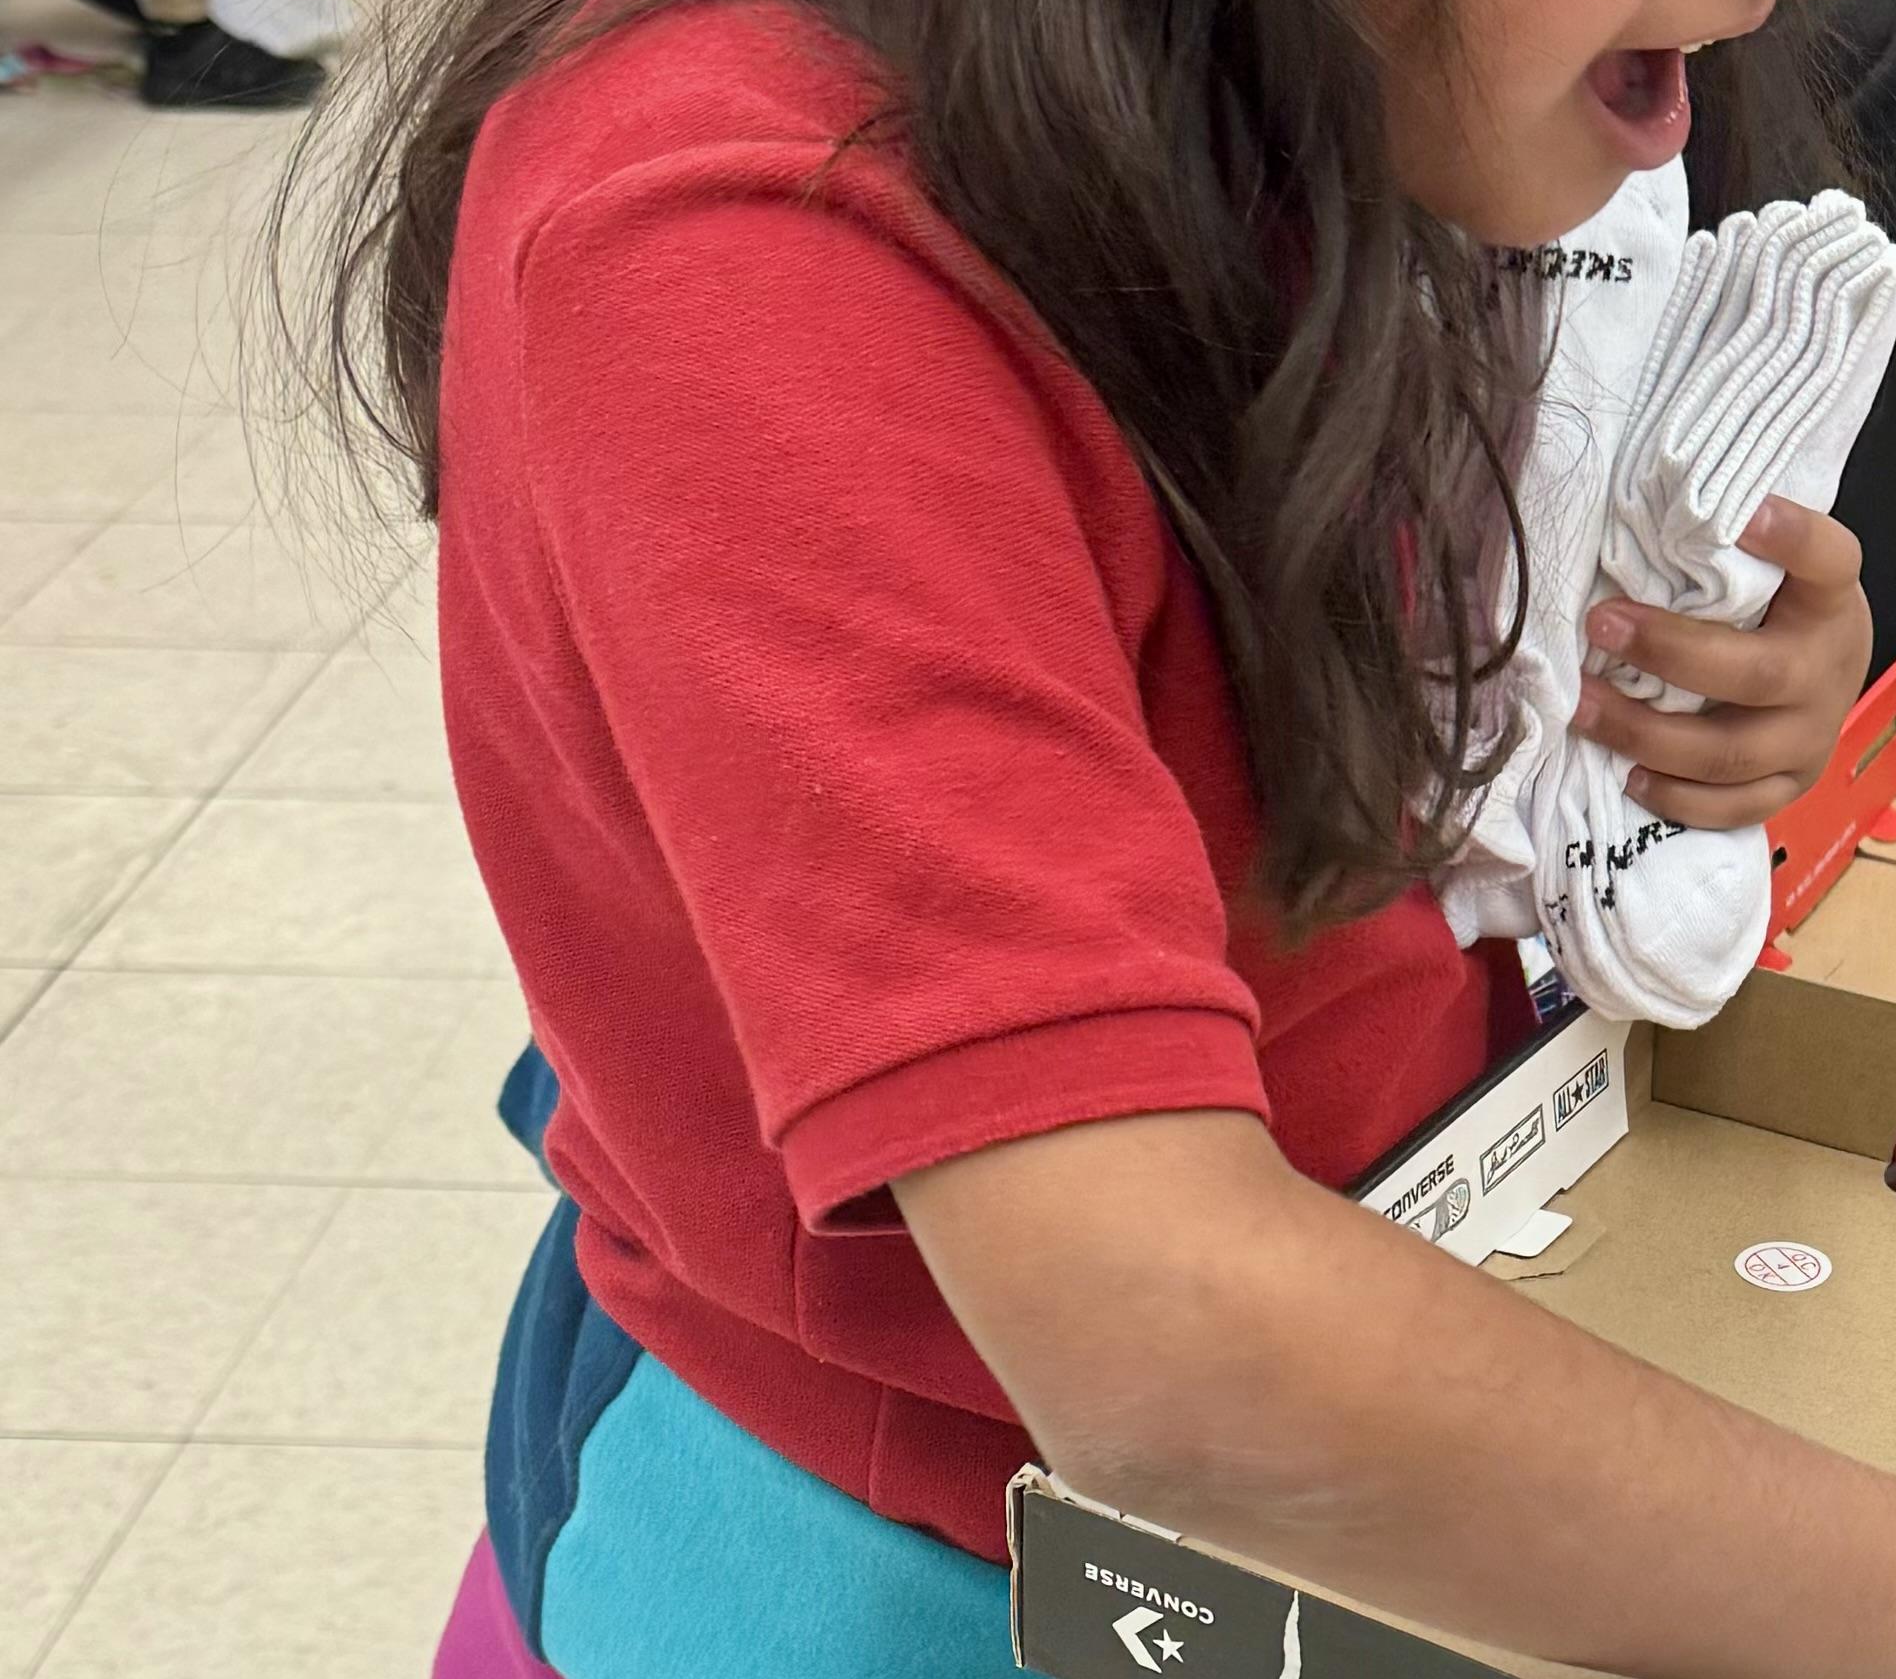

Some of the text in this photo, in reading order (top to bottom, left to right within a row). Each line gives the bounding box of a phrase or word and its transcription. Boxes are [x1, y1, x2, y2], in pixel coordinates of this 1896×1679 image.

[1557, 1057, 1607, 1124] ALL STAR
[1384, 1154, 1455, 1221] ONVERSE
[1083, 1562, 1214, 1625] CONVERSE
